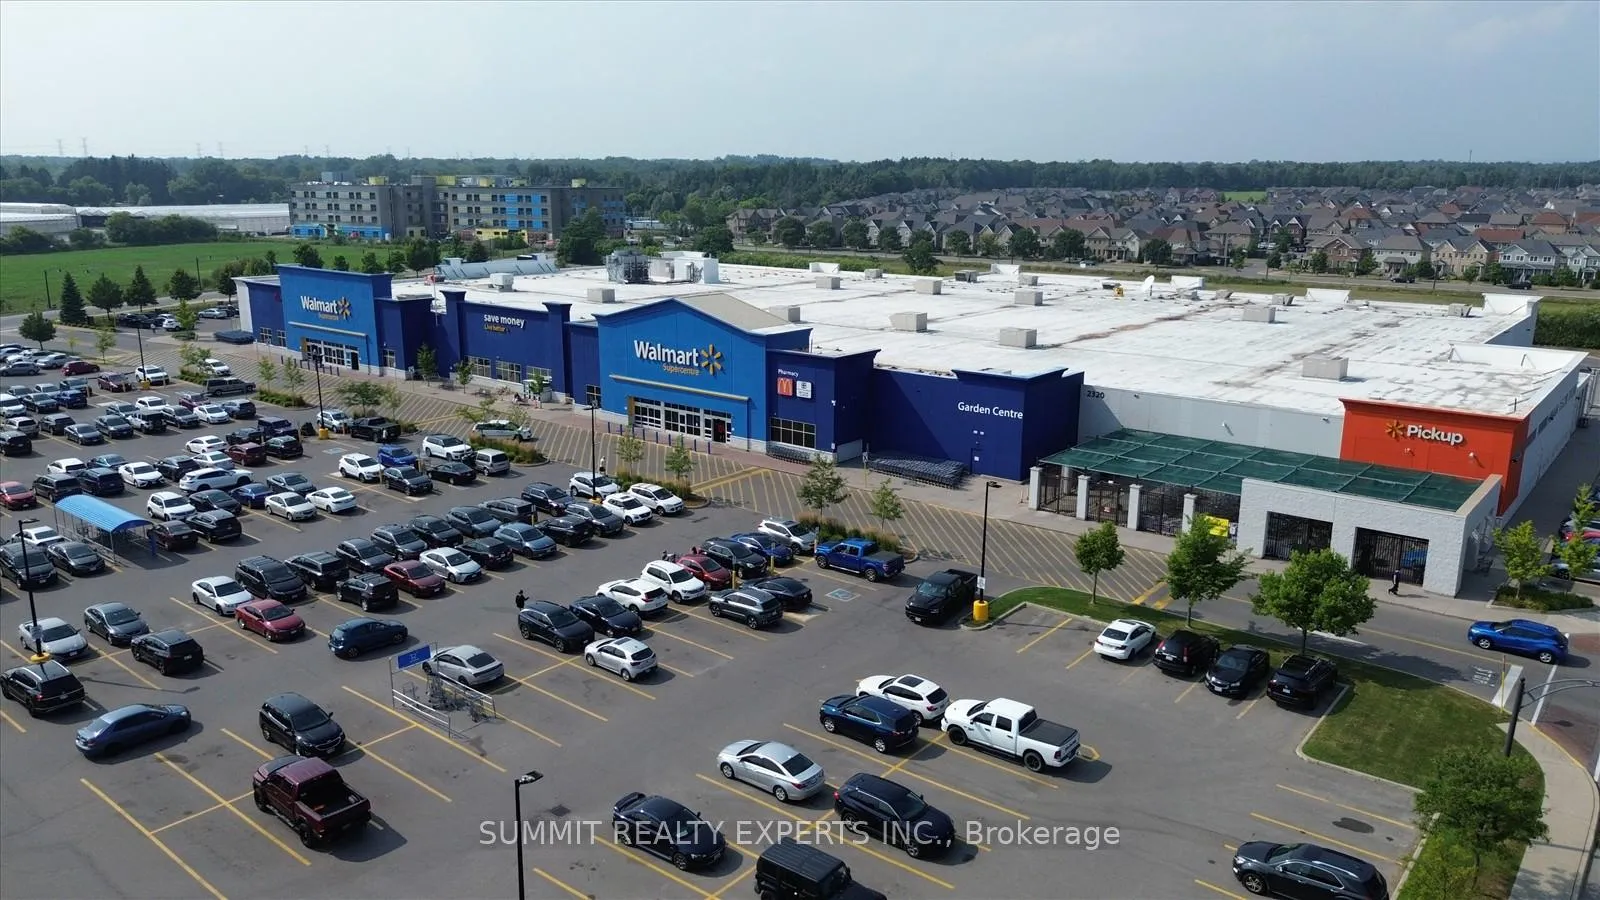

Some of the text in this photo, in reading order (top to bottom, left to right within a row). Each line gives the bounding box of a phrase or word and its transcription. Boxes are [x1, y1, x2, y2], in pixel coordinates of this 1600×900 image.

[301, 296, 338, 314] Walmart
[484, 314, 499, 323] save
[500, 316, 525, 329] money
[634, 340, 699, 367] Walmart
[1087, 390, 1105, 400] 2320
[957, 402, 1024, 419] Garden Centre
[1406, 424, 1464, 446] Pickup
